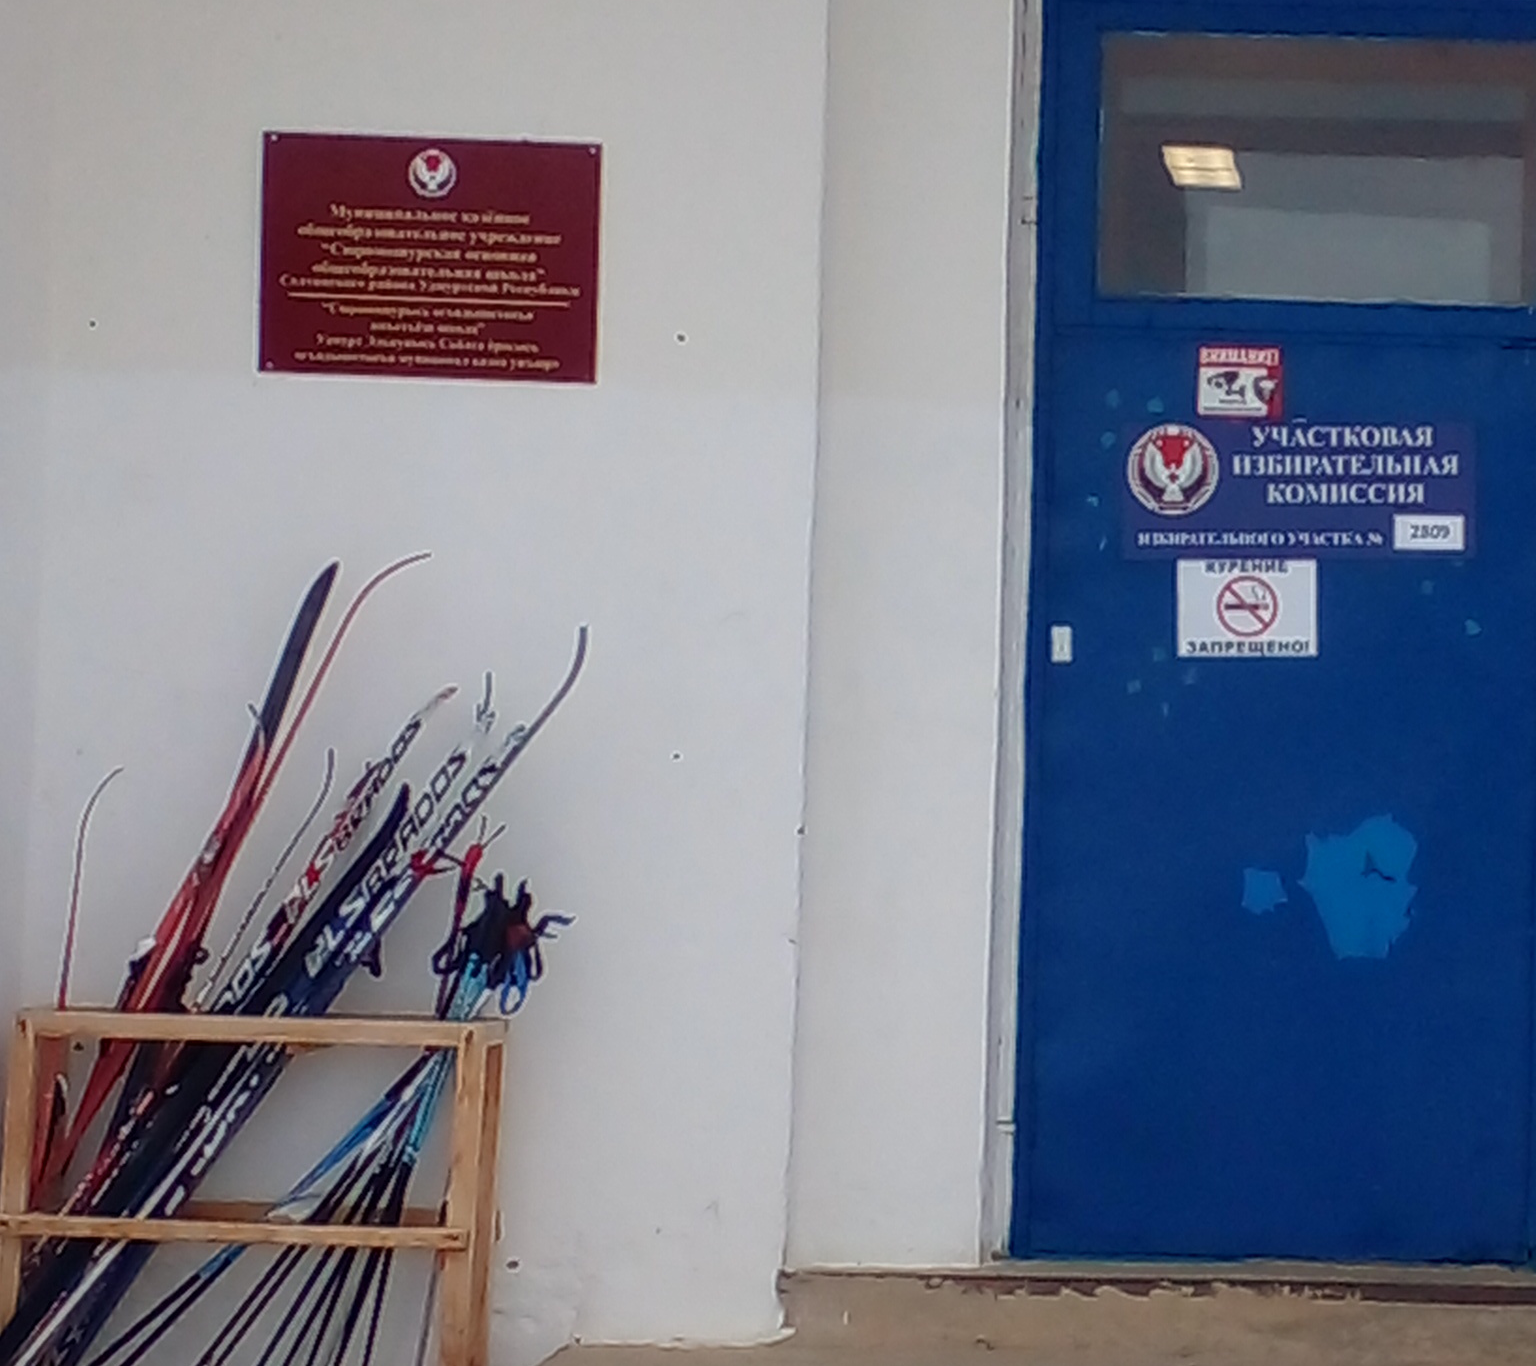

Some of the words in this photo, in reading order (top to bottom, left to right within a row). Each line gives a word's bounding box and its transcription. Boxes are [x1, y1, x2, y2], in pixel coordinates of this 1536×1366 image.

[1252, 426, 1434, 448] УЧАСТКОВАЯ
[1232, 453, 1460, 477] ИЗБИРАТЕЛЬНАЯ
[1266, 483, 1425, 505] КОМИССИЯ
[1288, 532, 1363, 547] УЧАСТКА
[1205, 561, 1288, 574] КУРЕНИЕ
[1186, 640, 1311, 656] ЗАПРЕЩЕНО!
